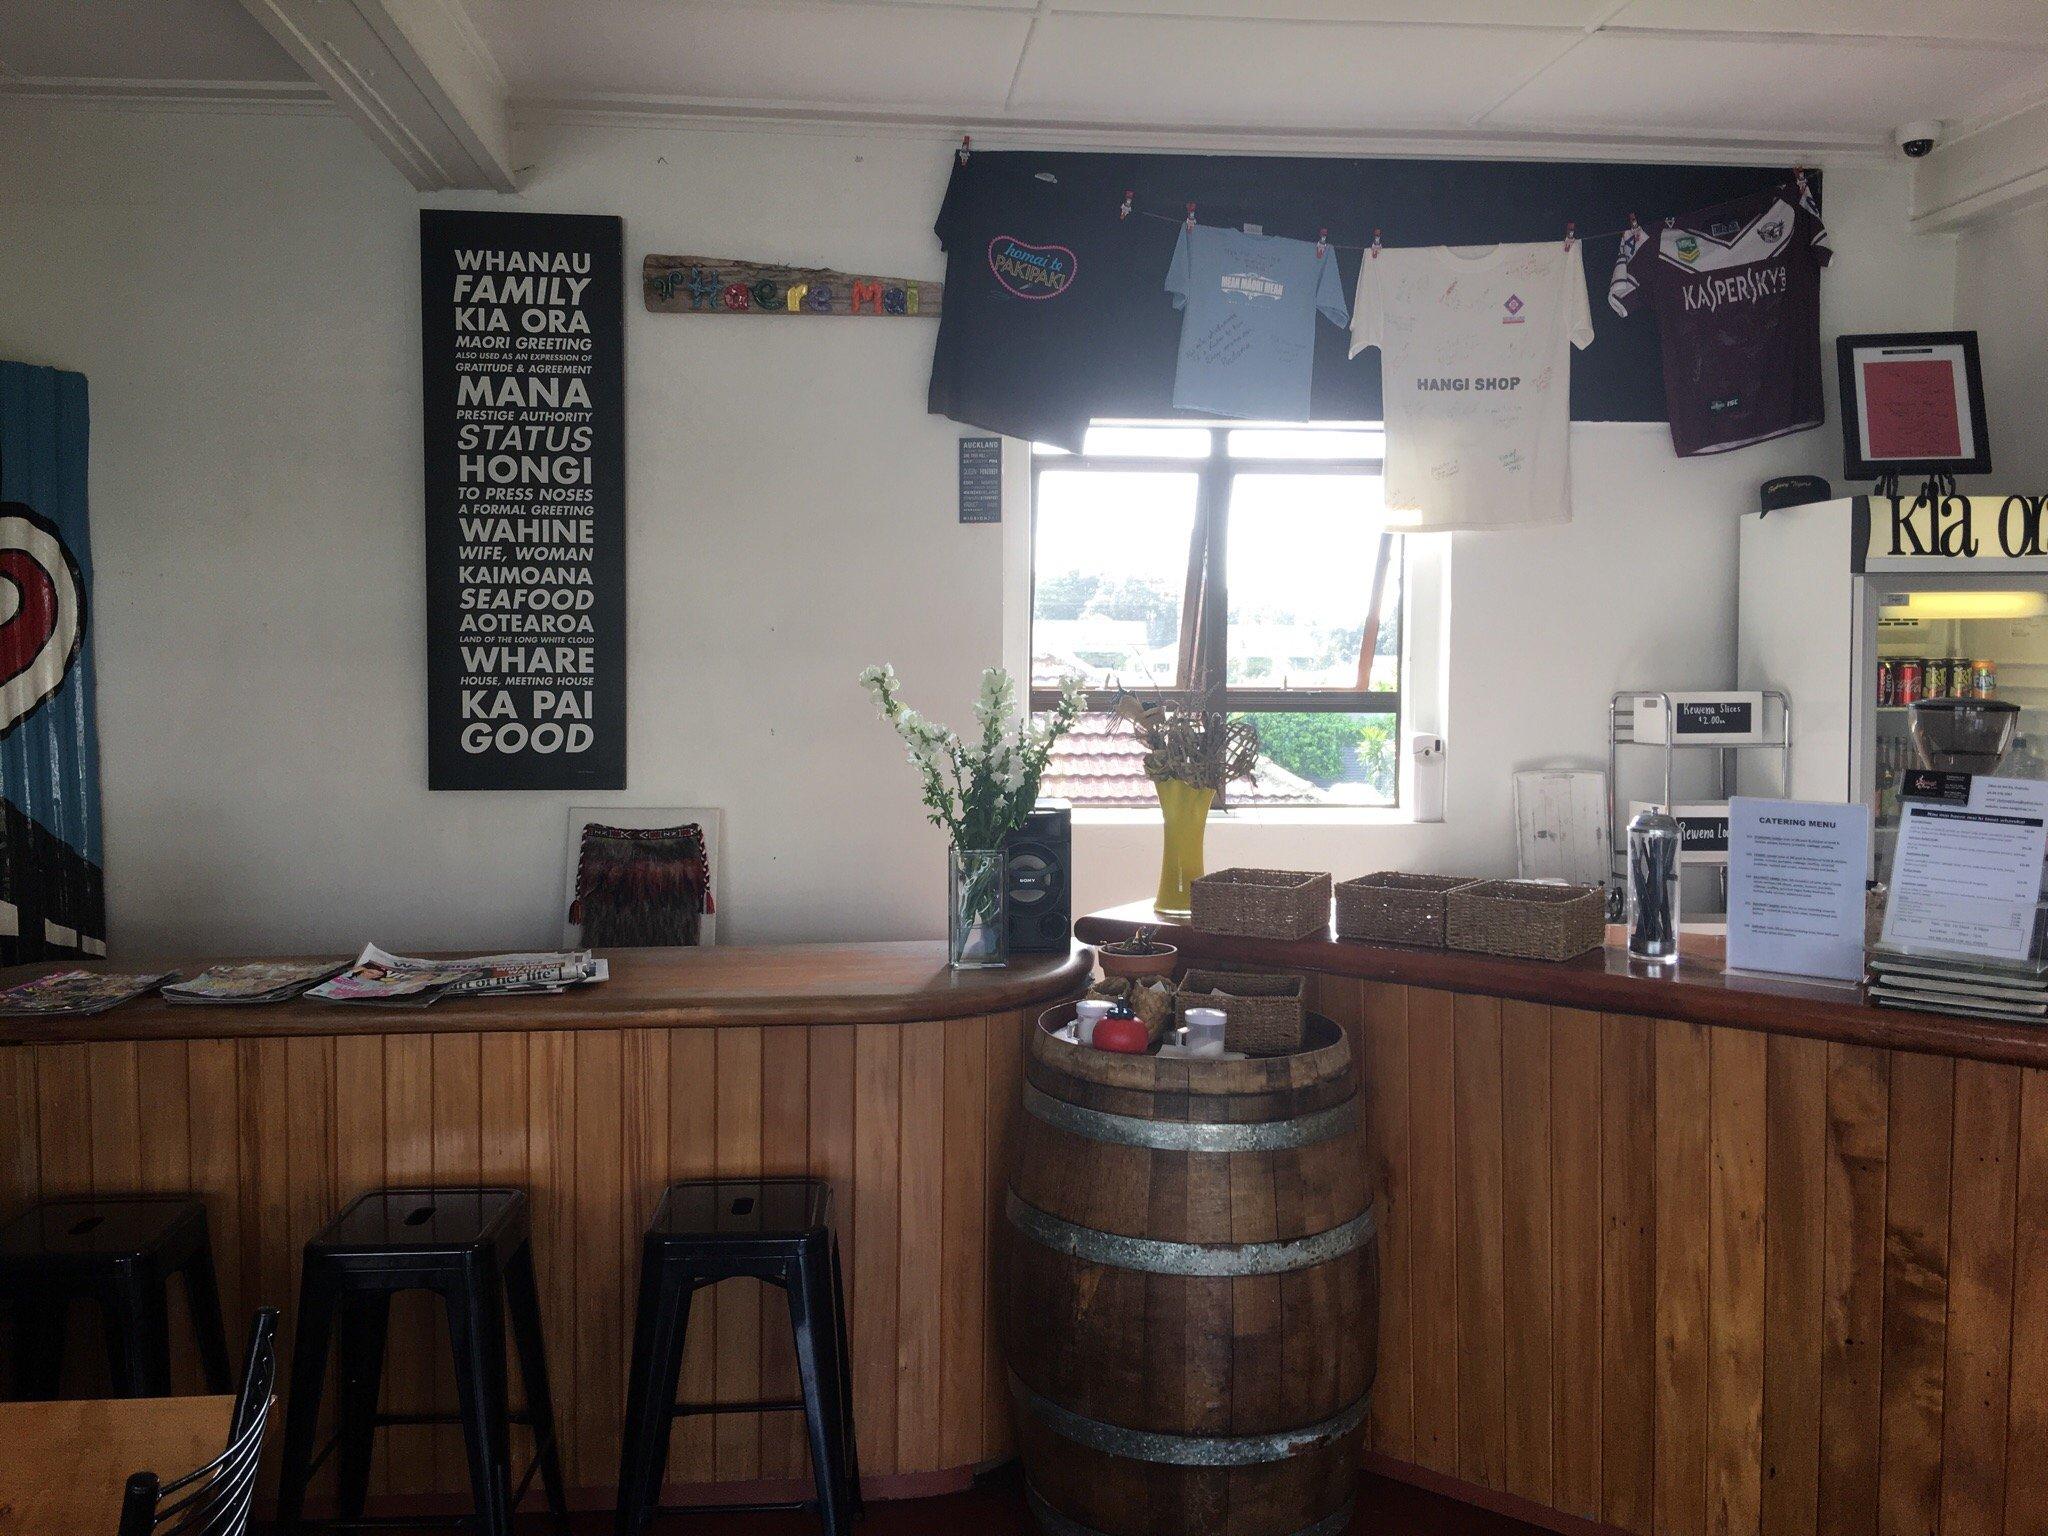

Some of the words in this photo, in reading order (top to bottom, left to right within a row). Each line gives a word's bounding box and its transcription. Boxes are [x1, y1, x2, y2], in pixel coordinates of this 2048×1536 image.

[455, 250, 590, 273] WHANAU
[454, 275, 591, 305] FAMILY
[1682, 267, 1779, 313] KASPERSKY
[456, 307, 510, 331] KIA
[522, 309, 590, 333] ORA
[456, 336, 510, 348] MAORI
[516, 337, 592, 351] GREETING
[456, 363, 513, 372] GRATITUDE
[517, 364, 524, 372] &
[529, 365, 592, 374] AGREEMENT
[457, 376, 592, 408] MANA
[1417, 378, 1470, 391] HANGI
[1474, 376, 1521, 391] SHOP
[457, 410, 514, 420] PRESTIGE
[519, 411, 593, 422] AUTHORITY
[458, 424, 592, 452] STATUS
[963, 441, 999, 449] AUCKLAND
[460, 455, 591, 484] HONGI
[458, 487, 479, 499] TO
[486, 488, 533, 500] PRESS
[539, 489, 593, 501] NOSES
[458, 504, 467, 513] A
[473, 504, 526, 514] FORMAL
[531, 505, 594, 516] GREETING
[459, 518, 593, 543] WAHINE
[459, 546, 507, 562] WIFE,
[516, 547, 593, 561] WOMAN
[459, 566, 593, 585] KAIMOANA
[460, 588, 594, 610] SEAFOOD
[460, 614, 594, 633] AOTEAROA
[461, 647, 594, 673] WHARE
[461, 677, 502, 687] HOUSE,
[505, 677, 553, 685] MEETING
[557, 677, 594, 685] HOUSE
[462, 690, 518, 718] KA
[534, 691, 592, 719] PAI
[1719, 703, 1741, 714] Slices
[461, 723, 594, 753] GOOD
[1759, 817, 1806, 828] CATERING
[1809, 820, 1837, 829] MENU
